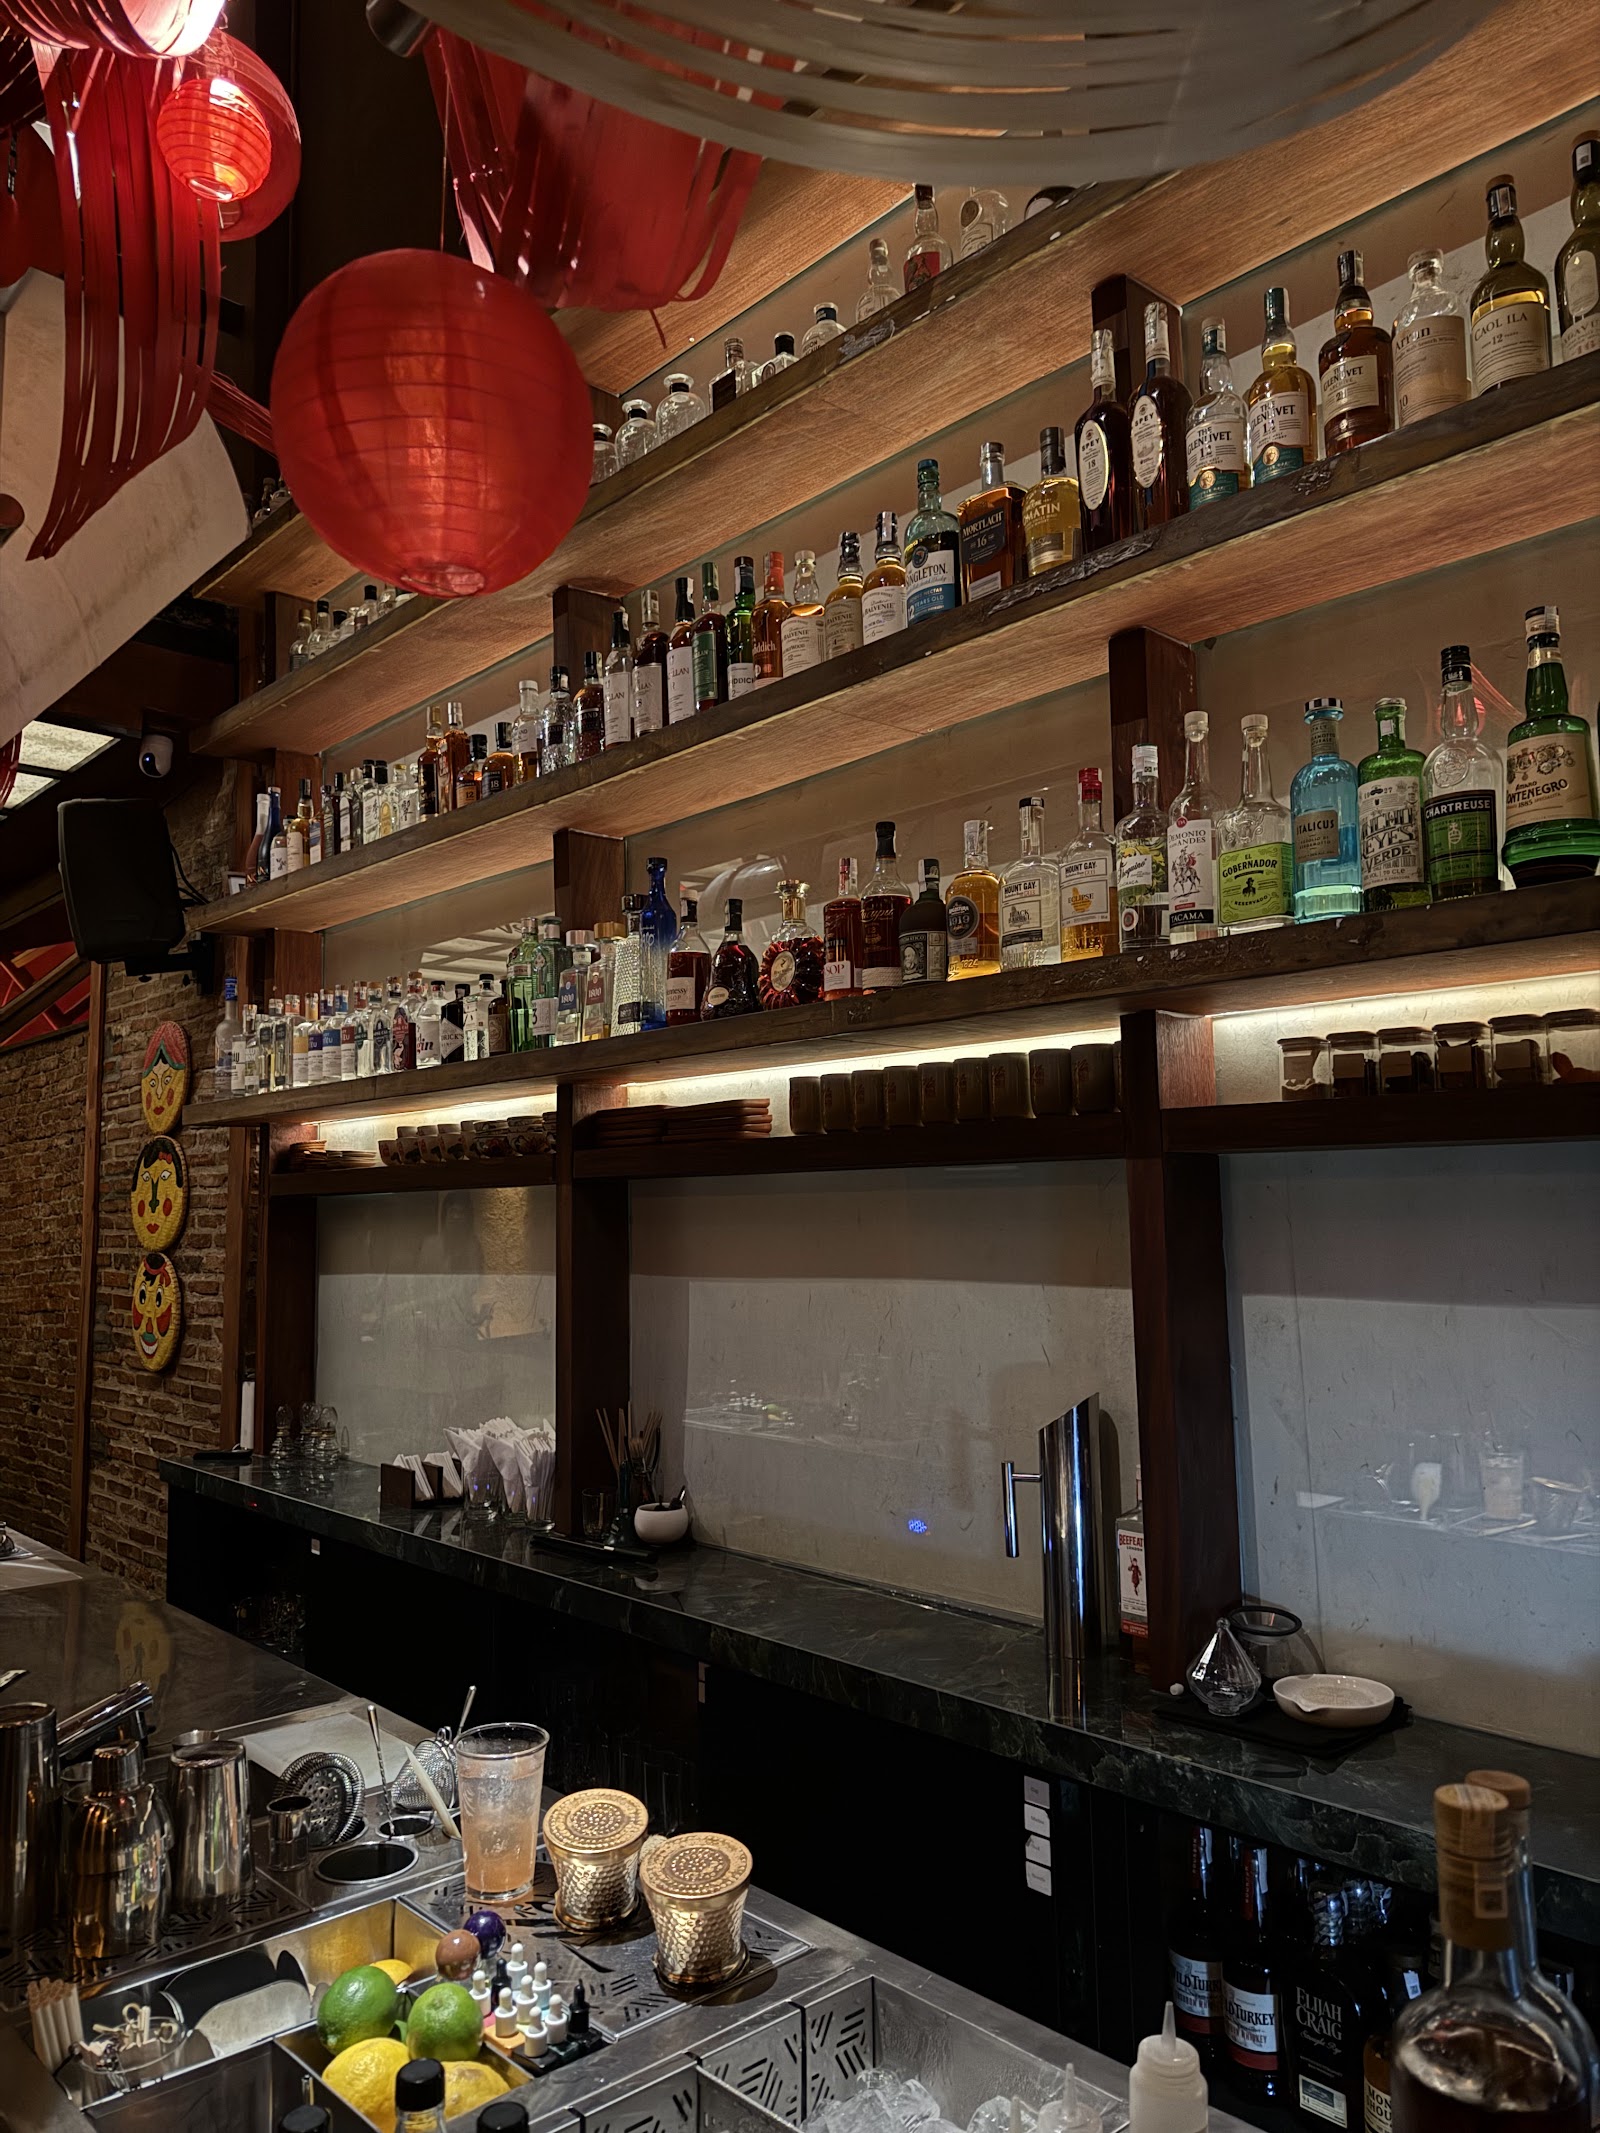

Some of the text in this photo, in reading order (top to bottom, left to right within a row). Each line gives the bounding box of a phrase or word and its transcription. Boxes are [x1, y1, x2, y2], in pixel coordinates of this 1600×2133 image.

[1474, 312, 1528, 342] CAOL ILA
[1492, 333, 1504, 346] 12
[1323, 365, 1364, 392] GLENVET
[1134, 412, 1154, 427] SPEY
[1197, 426, 1212, 438] THE
[1081, 437, 1100, 452] SPEY
[1187, 430, 1233, 456] GLENLIVET
[1087, 459, 1096, 470] 18
[1023, 502, 1060, 526] OMATIN
[962, 510, 1004, 538] MORTLACH
[977, 533, 988, 549] 16
[931, 595, 945, 604] OLD
[752, 642, 776, 653] iddich
[669, 667, 690, 679] LLAN
[605, 692, 625, 701] LLAN
[491, 779, 500, 788] 18
[466, 791, 475, 800] 12
[1507, 778, 1568, 804] ONTENEGRO
[1425, 799, 1491, 820] CHARTREUSE
[1518, 799, 1533, 808] 1885
[1296, 819, 1335, 836] ITALICUS
[1177, 836, 1207, 847] ANDES
[1366, 845, 1412, 874] VERDE
[1064, 863, 1082, 874] MOUNT
[1083, 861, 1096, 870] GAY
[1222, 859, 1278, 878] GOBERNADOR
[1004, 884, 1022, 895] MOUNT
[1023, 881, 1037, 890] GAY
[1068, 892, 1094, 904] ECLIPSE
[1234, 895, 1268, 906] RESERVADO
[1171, 911, 1205, 923] TACAMA
[825, 964, 845, 975] SOP
[1296, 1986, 1342, 2023] ELIJAH
[1234, 2002, 1275, 2026] TURKEY
[1296, 2004, 1342, 2041] CRAIG
